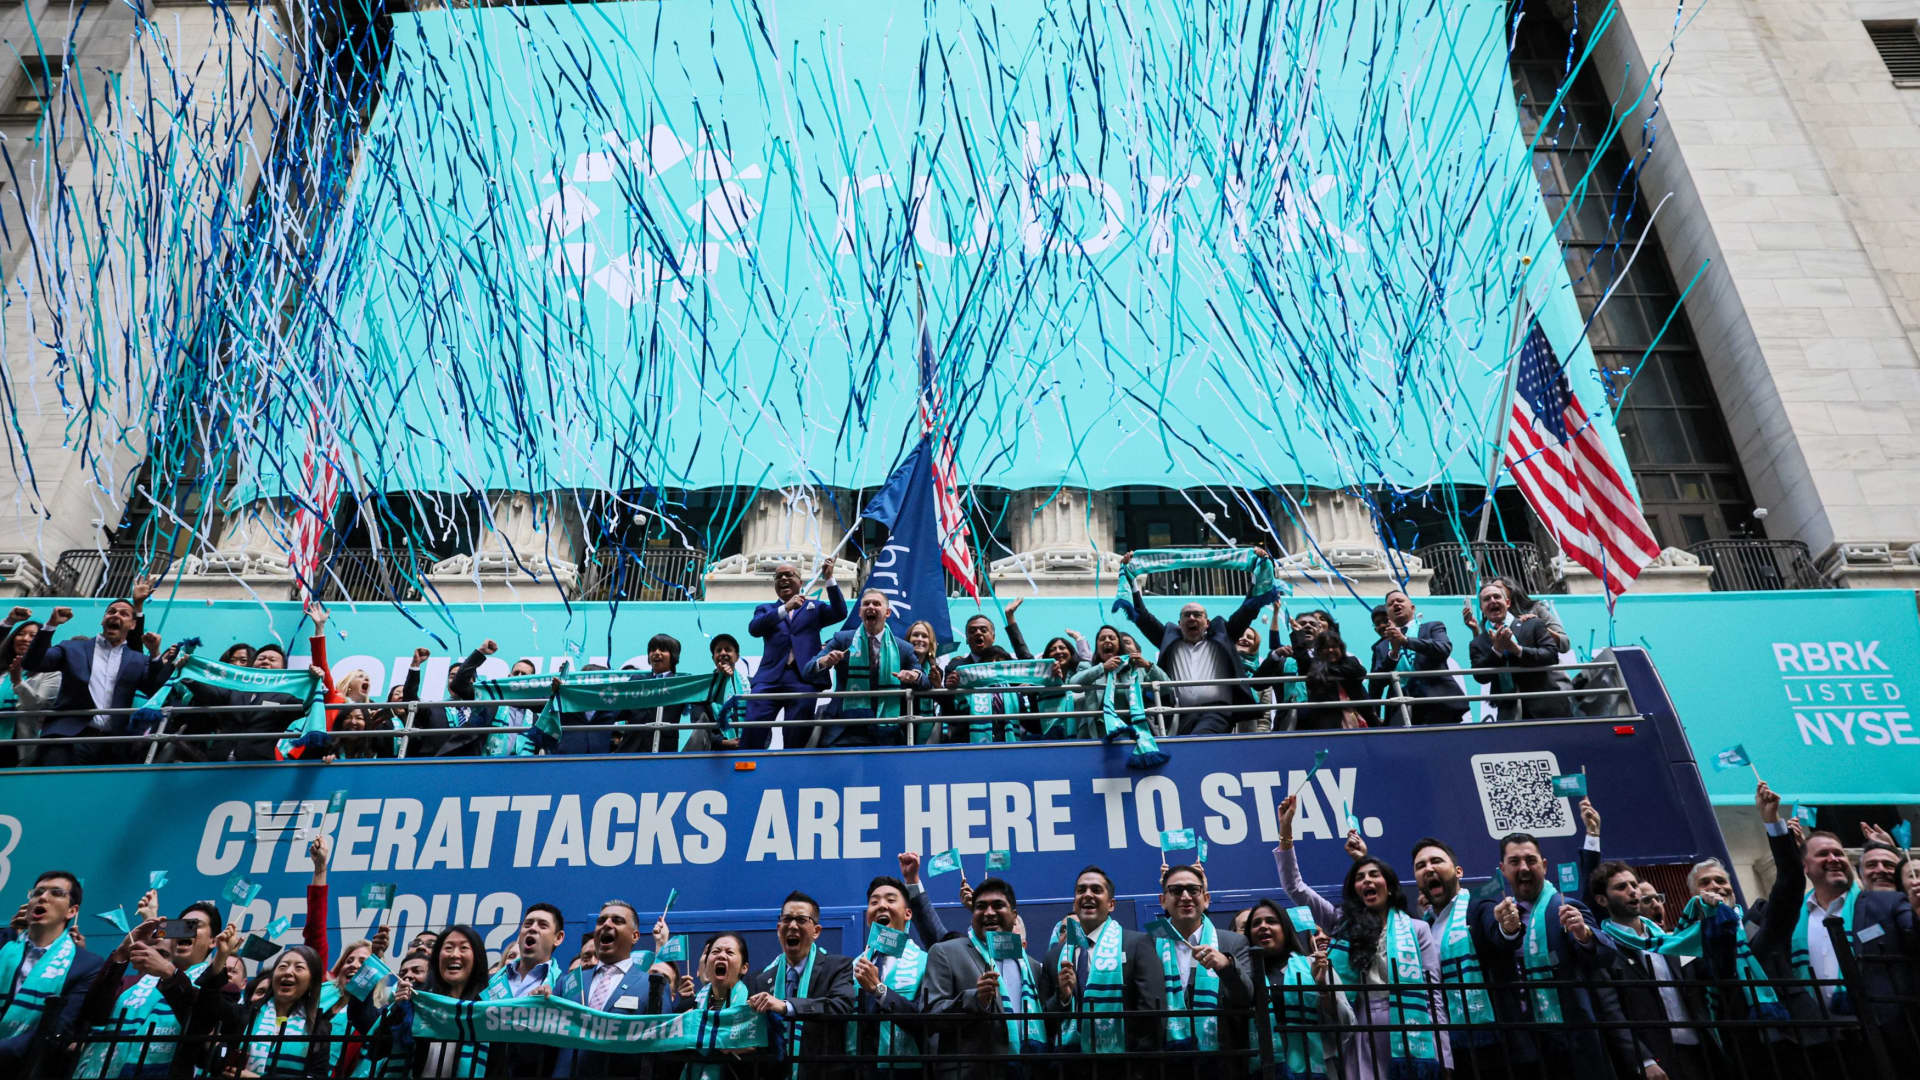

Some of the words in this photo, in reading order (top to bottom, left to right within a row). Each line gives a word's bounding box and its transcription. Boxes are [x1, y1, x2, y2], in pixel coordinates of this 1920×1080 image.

[836, 120, 1366, 257] rubrik
[1001, 662, 1033, 678] THE
[1771, 640, 1890, 672] RBRK
[233, 669, 290, 686] rubrik
[624, 684, 672, 699] rubrik
[1784, 682, 1901, 702] LISTED
[1794, 711, 1920, 746] NYSE
[196, 790, 729, 876] CYBERATTACKS
[745, 785, 882, 862] ARE
[903, 778, 1077, 859] HERE
[1093, 775, 1184, 849] TO
[1203, 766, 1385, 847] STAY.
[485, 1004, 572, 1037] SECURE
[579, 1013, 619, 1041] THE
[625, 1015, 685, 1042] DATA
